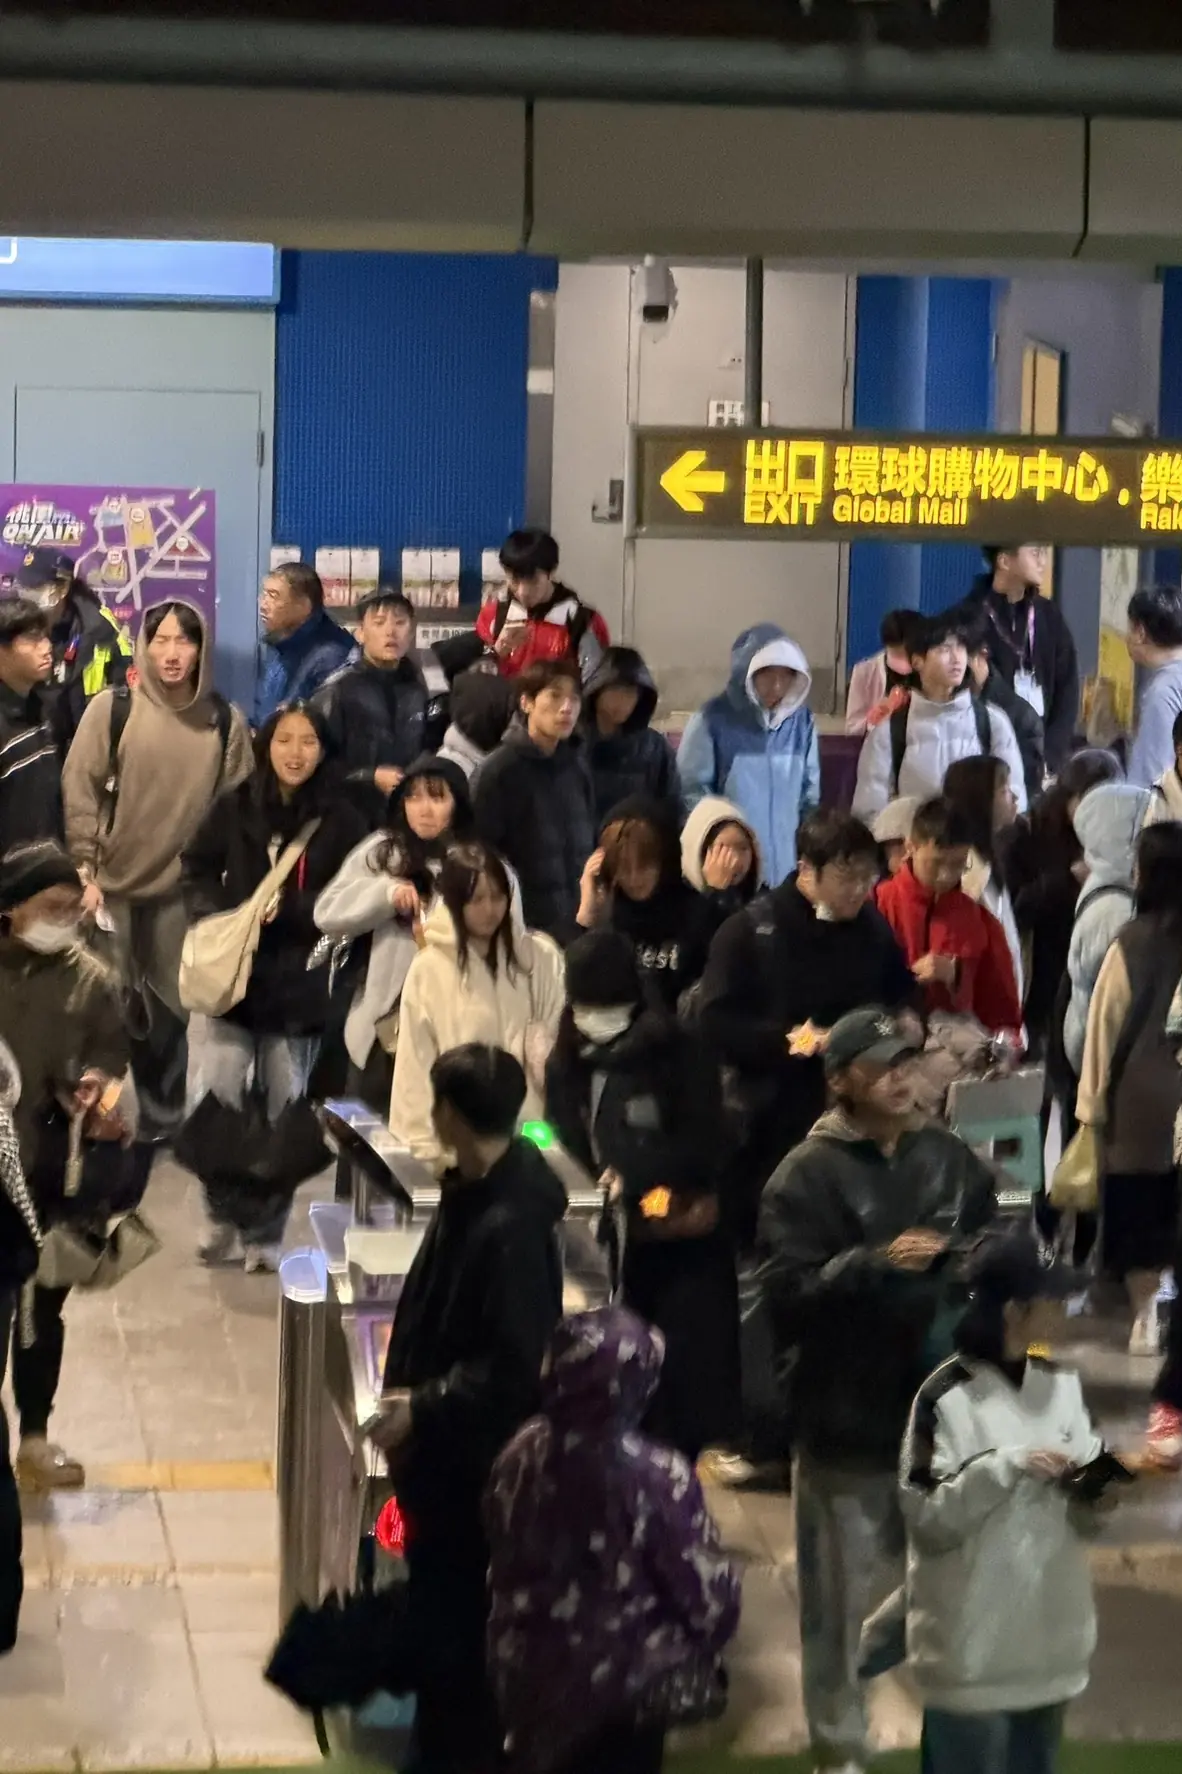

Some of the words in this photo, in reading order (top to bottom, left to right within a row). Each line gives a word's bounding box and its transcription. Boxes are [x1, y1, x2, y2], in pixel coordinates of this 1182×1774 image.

[746, 439, 824, 496] 出口
[744, 490, 821, 525] EXIT
[833, 495, 910, 524] Global
[918, 497, 968, 526] Mall
[636, 943, 679, 971] est
